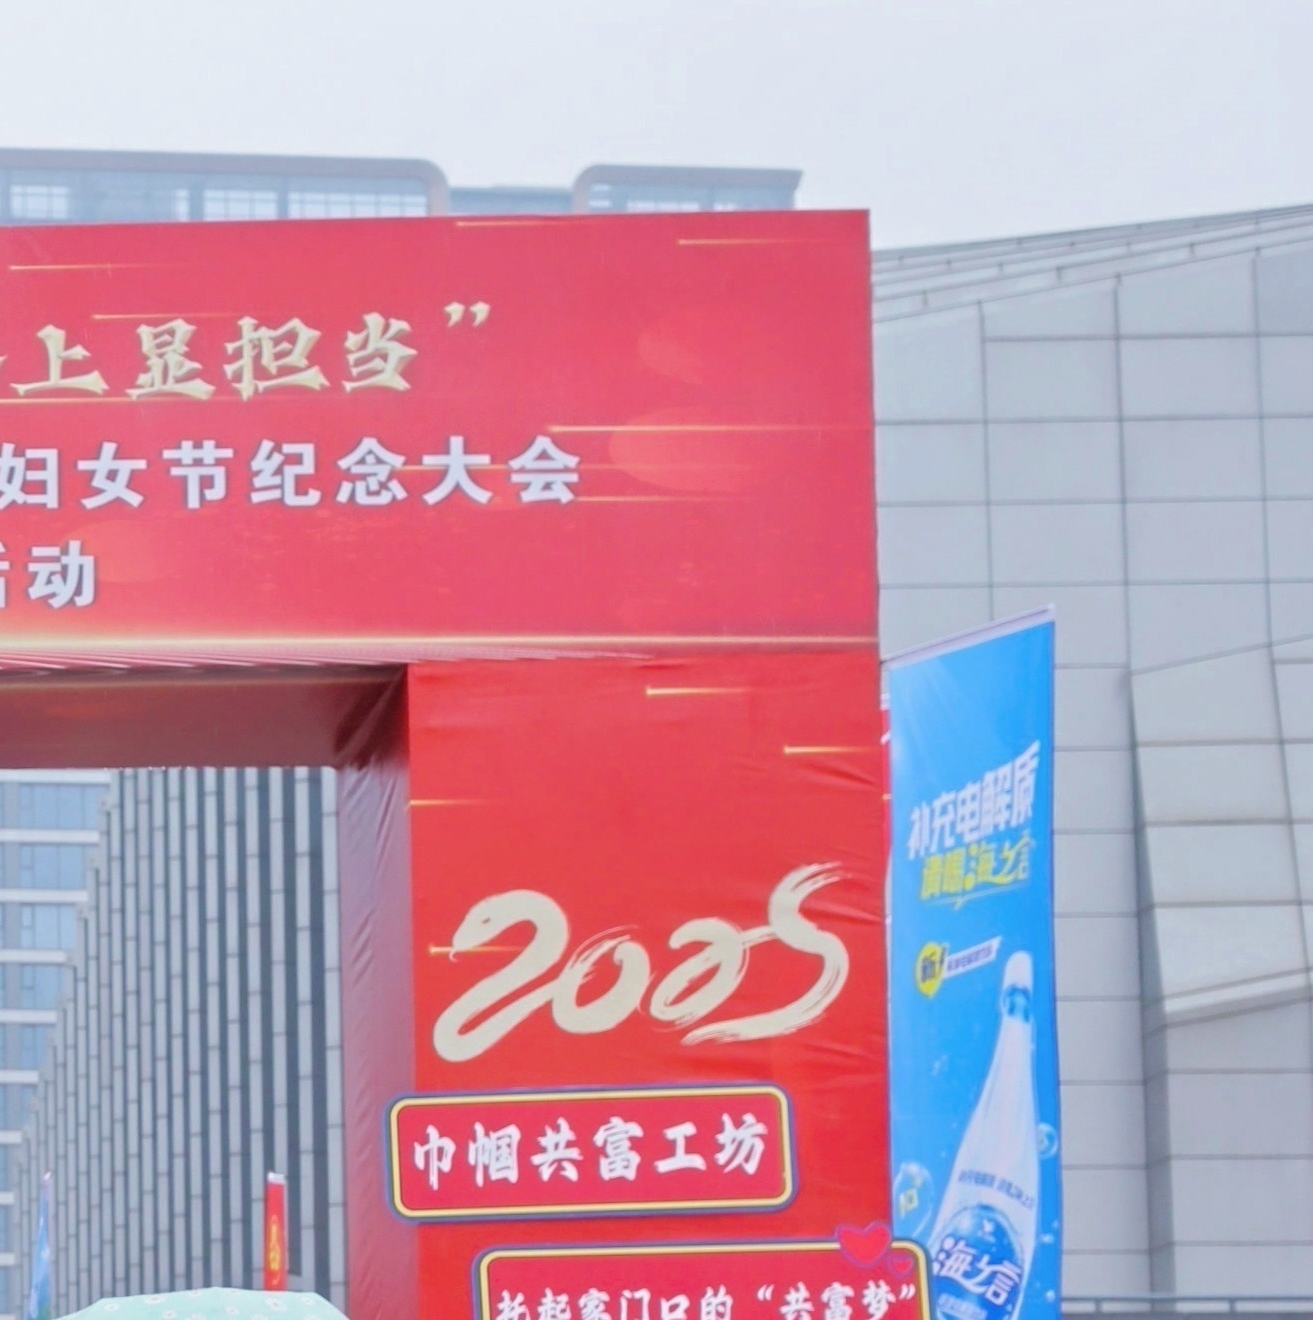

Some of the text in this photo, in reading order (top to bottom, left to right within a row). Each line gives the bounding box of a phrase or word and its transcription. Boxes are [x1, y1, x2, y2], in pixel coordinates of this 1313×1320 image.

[907, 740, 1041, 860] 补充电解质
[412, 1112, 769, 1191] 巾帼共富工坊
